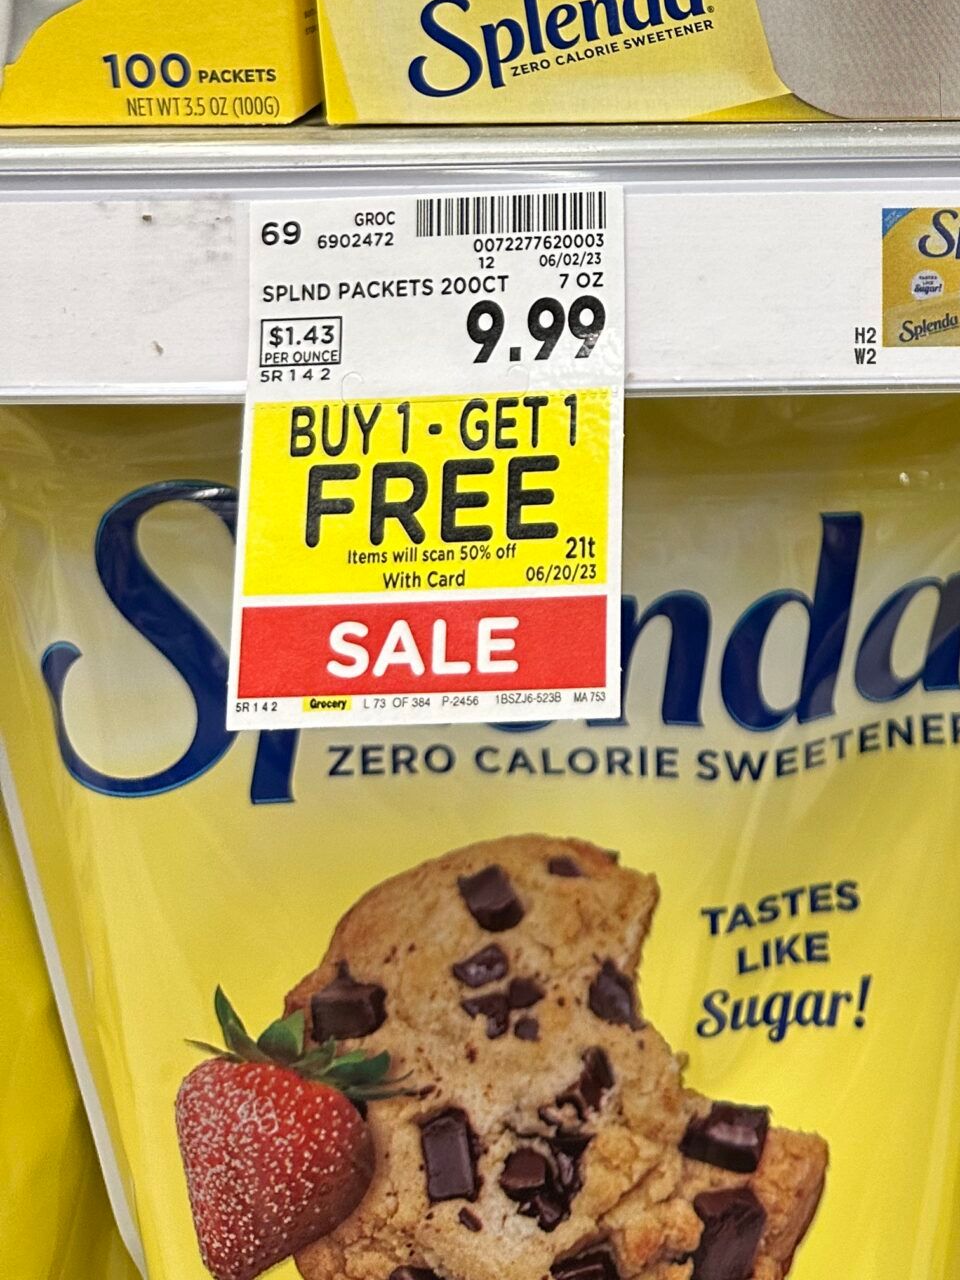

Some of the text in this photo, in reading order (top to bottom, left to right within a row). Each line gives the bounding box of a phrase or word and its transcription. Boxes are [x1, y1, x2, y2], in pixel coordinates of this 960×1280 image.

[510, 19, 714, 77] ZERO CALORIE SWEETENER
[102, 52, 276, 89] 100 PACKETS
[127, 95, 280, 117] NET WT 3.5 OZ (100G)
[354, 211, 396, 227] GROC
[261, 221, 301, 246] 69
[317, 232, 395, 249] 6902472
[473, 234, 605, 253] 0072277620003
[478, 257, 495, 269] 12
[539, 252, 602, 268] 06/02/23
[262, 275, 509, 303] SPLND PACKETS 200CT
[559, 272, 604, 289] 7 OZ
[269, 324, 335, 347] $1.43
[466, 294, 606, 364] 9.99
[854, 327, 876, 344] H2
[899, 312, 958, 342] Splenda
[264, 350, 339, 364] PER OUNCE
[854, 348, 876, 365] W2
[302, 368, 314, 381] 4
[320, 368, 331, 381] 2
[289, 401, 382, 458] BUY
[397, 400, 411, 454] 1
[459, 395, 549, 451] GET
[563, 393, 578, 447] 1
[305, 454, 560, 548] FREE
[347, 544, 517, 565] Items will scan 50% off
[565, 536, 596, 560] 21t
[383, 569, 466, 589] With Card
[525, 563, 597, 582] 06/20/23
[326, 615, 520, 679] SALE
[310, 697, 347, 711] Grocery
[363, 697, 431, 709] L 73 OF 384
[442, 695, 479, 707] P-2456
[574, 691, 606, 703] MA 753
[327, 743, 456, 778] ZERO
[474, 745, 679, 779] CALORIE
[701, 880, 861, 937] TASTES
[737, 931, 830, 975] LIKE
[696, 974, 872, 1043] Sugar!
